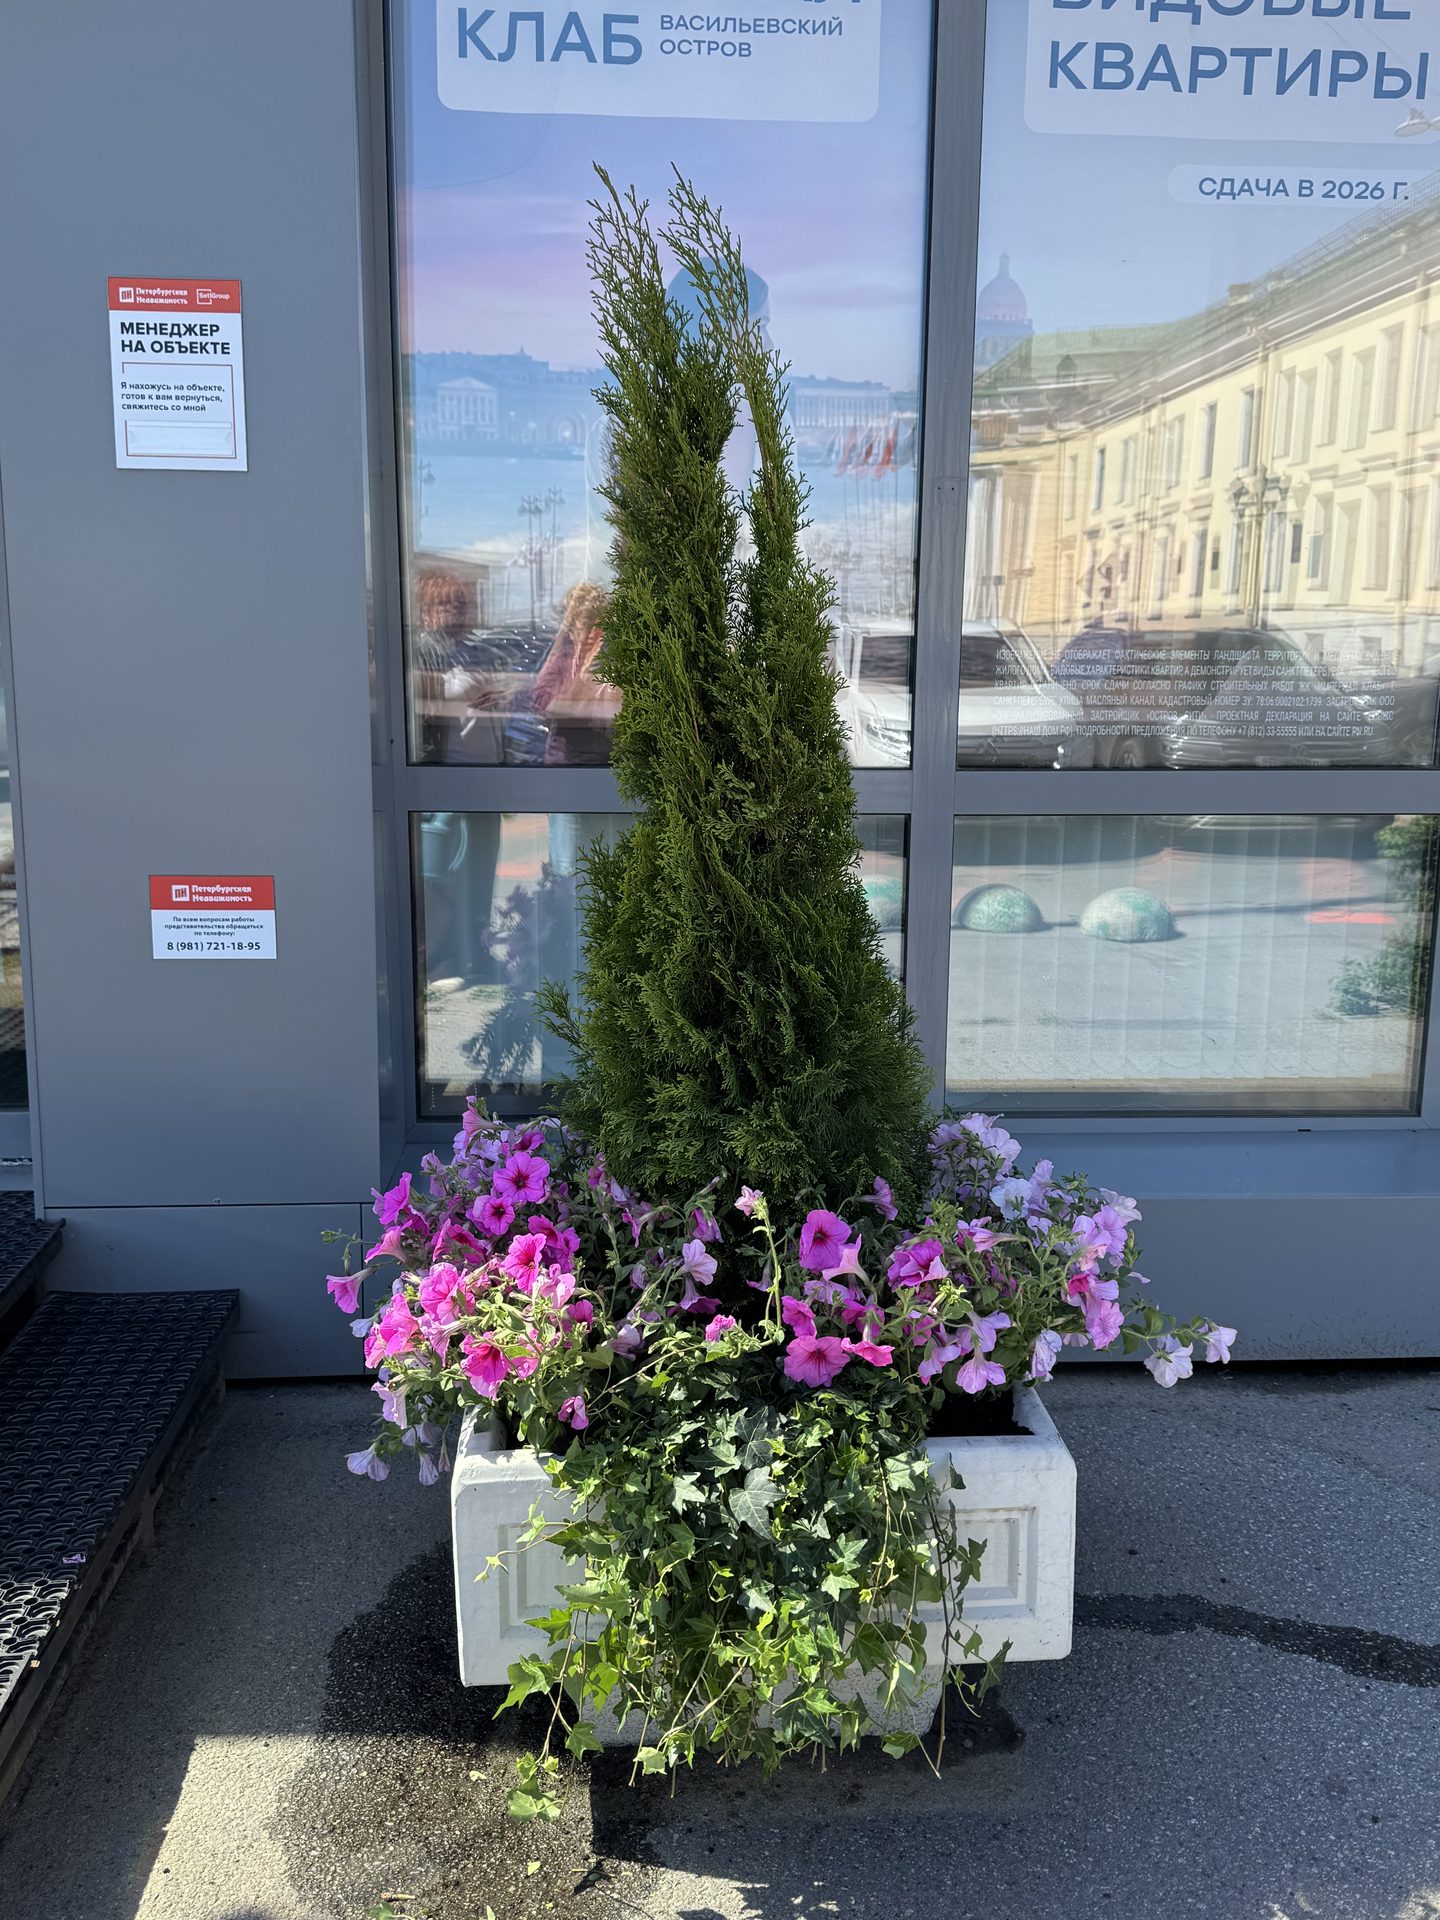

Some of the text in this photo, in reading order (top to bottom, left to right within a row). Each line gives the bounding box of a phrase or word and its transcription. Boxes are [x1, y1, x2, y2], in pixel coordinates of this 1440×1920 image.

[660, 14, 843, 36] ВАСИЛЬЕВСКИЙ
[457, 8, 643, 65] КЛАБ
[660, 39, 752, 57] ОСТРОВ
[1048, 40, 1429, 100] КВАРТИРЫ
[1198, 177, 1409, 200] СДАЧА В 2026 Г.
[136, 288, 188, 297] Петербургская
[136, 297, 188, 305] Недвижимость
[120, 322, 220, 338] МЕНЕДЖЕР
[121, 340, 231, 355] НА ОБЪЕКТЕ
[120, 381, 127, 389] Я
[129, 383, 172, 392] нахожусь
[186, 384, 225, 393] объекте,
[175, 395, 223, 403] вернуться,
[121, 403, 169, 411] свяжитесь
[183, 404, 206, 412] мной
[1065, 650, 1110, 660] ОТОБРАЖАЕТ
[1114, 650, 1167, 660] ФАКТИЧЕСКИЕ
[1170, 650, 1210, 660] ЭЛЕМЕНТЫ
[1213, 651, 1260, 662] ЛАНДШАФТА
[1051, 665, 1085, 676] ВИДОВЫЕ
[1086, 665, 1151, 675] ХАРАКТЕРИСТИКИ
[1184, 665, 1190, 675] А
[1190, 666, 1253, 677] ДЕМОНСТРИРУЕТ
[1254, 666, 1275, 677] ВИДЫ
[1081, 680, 1100, 690] СРОК
[1104, 680, 1129, 691] СДАЧИ
[1132, 680, 1171, 690] СОГЛАСНО
[1174, 680, 1208, 690] ГРАФИКУ
[1211, 681, 1268, 690] СТРОИТЕЛЬНЫХ
[1298, 681, 1310, 690] ЖК
[1060, 696, 1083, 705] УЛИЦА
[1086, 694, 1128, 705] МАСЛЯНЫЙ
[1130, 696, 1156, 706] КАНАЛ,
[1159, 694, 1212, 706] КАДАСТРОВЫЙ
[1214, 696, 1240, 705] НОМЕР
[1326, 696, 1376, 705] ЗАСТРОИК
[1379, 696, 1396, 705] ООО
[1090, 709, 1140, 721] ЗАСТРОЙЩИК
[1216, 711, 1259, 721] ПРОЕКТНАЯ
[1265, 711, 1313, 722] ДЕКЛАРАЦИЯ
[1320, 711, 1330, 721] НА
[1337, 709, 1361, 721] САЙТЕ
[1077, 726, 1129, 737] ПОДРОБНОСТИ
[1131, 726, 1184, 737] ПРЕДЛОЖЕНИЯ
[1187, 726, 1197, 736] ПО
[1199, 726, 1236, 736] ТЕЛЕФОНУ
[1237, 726, 1247, 736] +7
[1248, 726, 1264, 737] (812)
[1266, 726, 1297, 736] 33-55555
[1298, 726, 1314, 736] ИЛИ
[1315, 726, 1326, 736] НА
[1327, 724, 1350, 736] САЙТЕ
[191, 884, 252, 894] Петербургская
[192, 894, 253, 902] Недвижимость
[167, 941, 261, 952] 8 (981) 721-18-95
